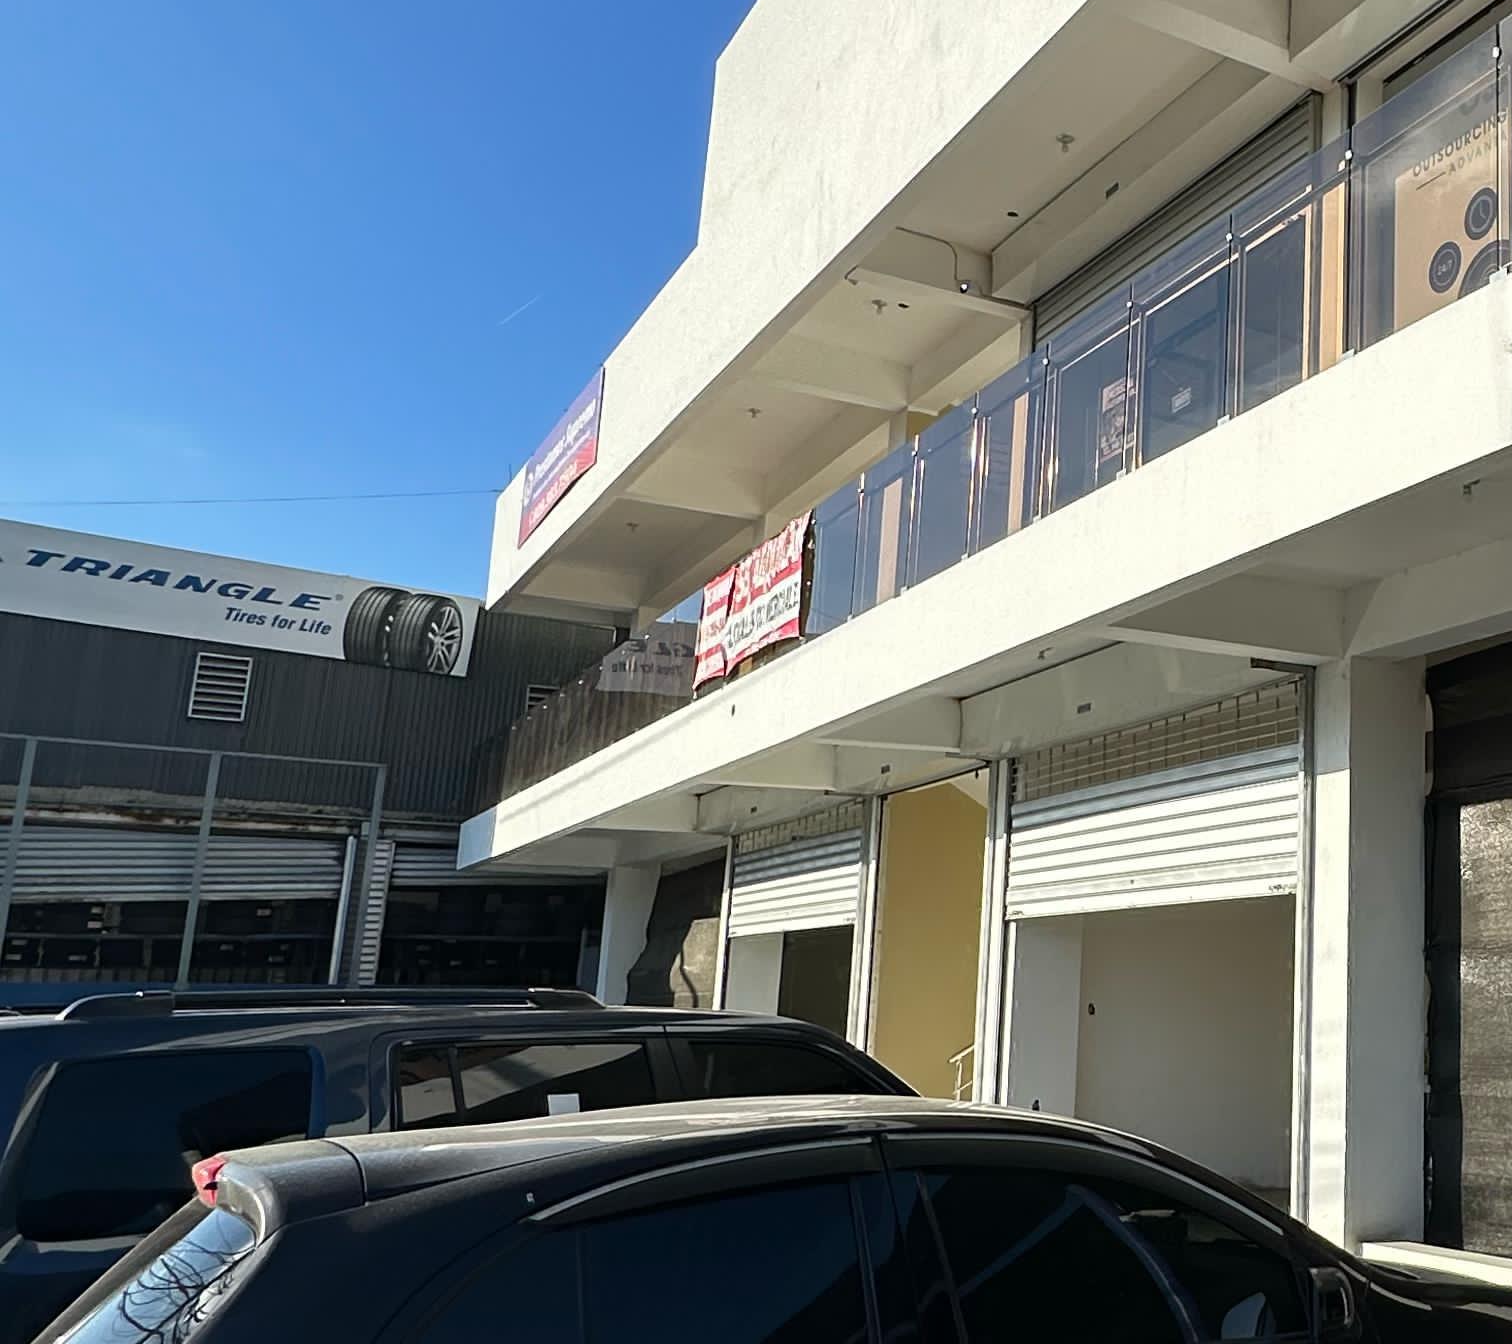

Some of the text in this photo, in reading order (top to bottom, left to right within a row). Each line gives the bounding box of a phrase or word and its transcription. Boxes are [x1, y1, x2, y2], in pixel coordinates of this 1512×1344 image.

[26, 550, 332, 611] TRIANGLE
[224, 606, 332, 636] Tires for Life
